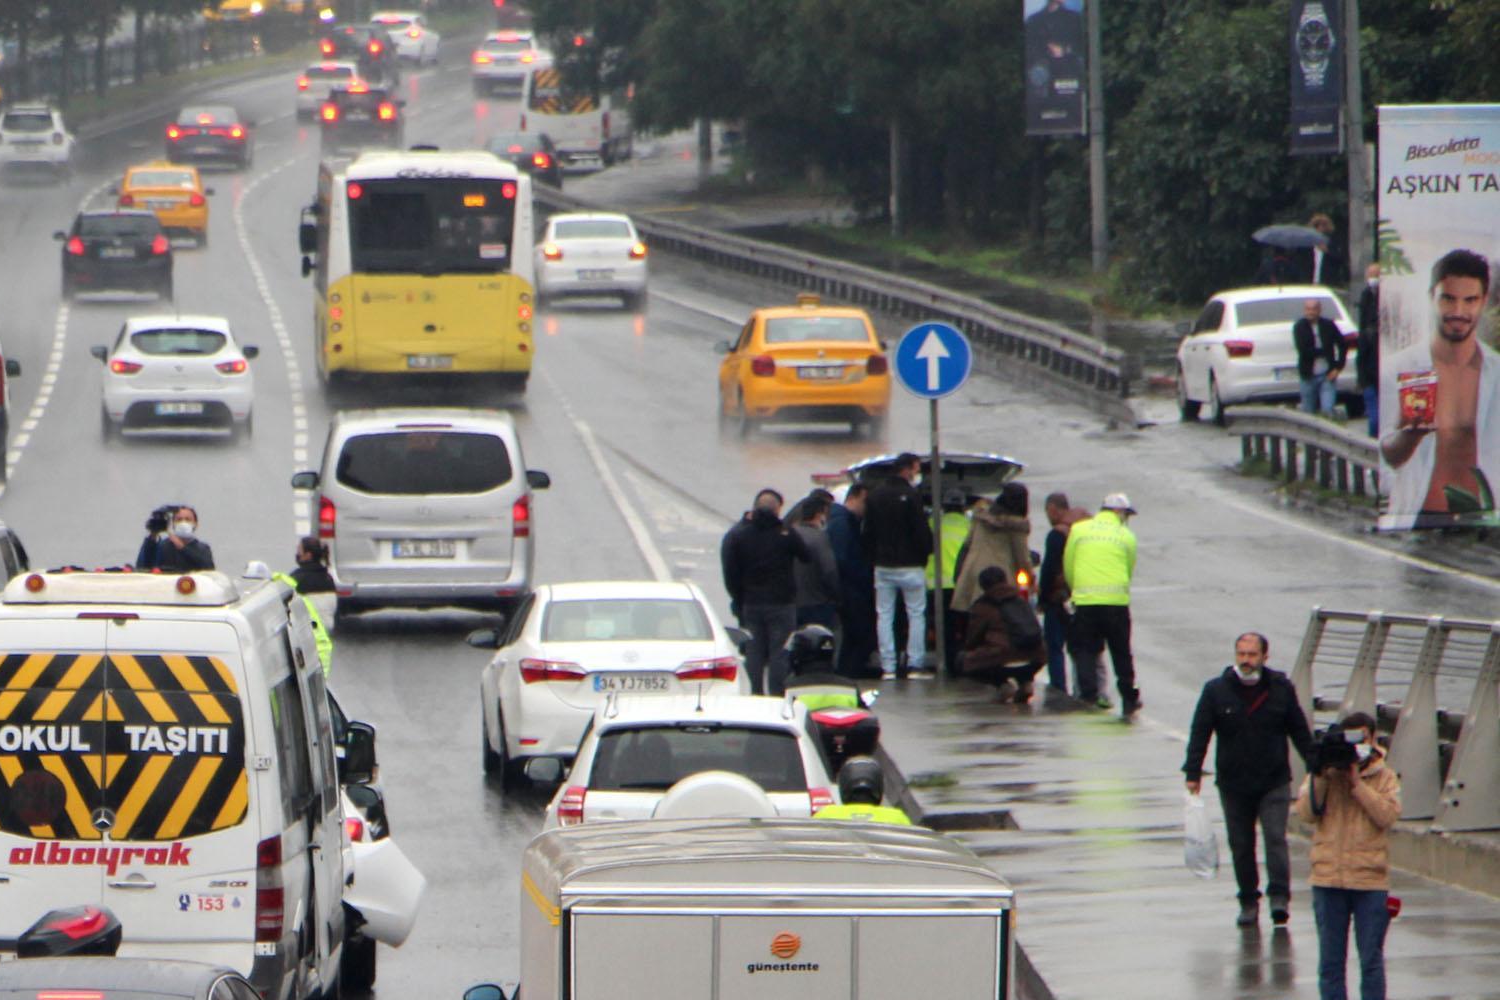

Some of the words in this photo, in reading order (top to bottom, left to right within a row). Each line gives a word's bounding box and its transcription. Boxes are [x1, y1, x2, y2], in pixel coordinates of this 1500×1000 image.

[1405, 136, 1480, 162] Biscolata
[1387, 173, 1460, 199] AŞKIN
[1468, 172, 1499, 192] TA
[124, 726, 228, 756] TAŞITI
[9, 841, 191, 876] albayrak
[197, 897, 224, 911] 153
